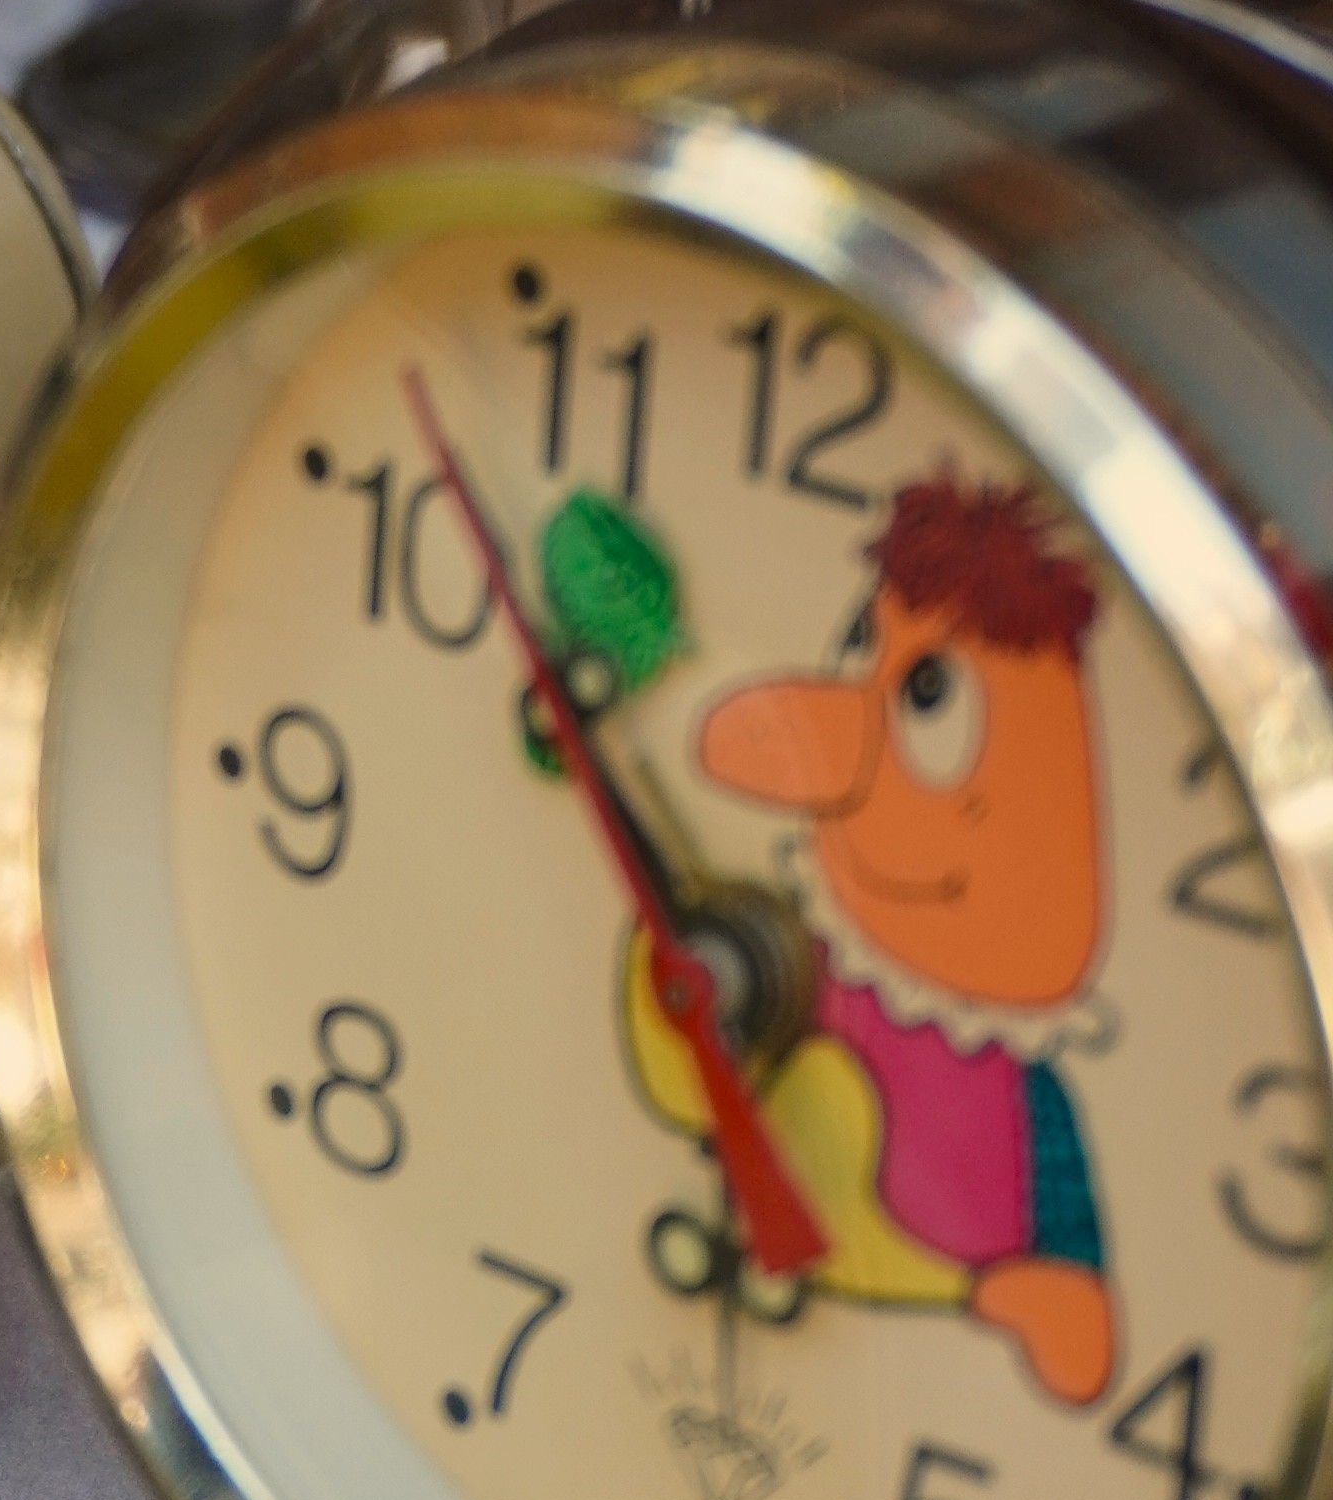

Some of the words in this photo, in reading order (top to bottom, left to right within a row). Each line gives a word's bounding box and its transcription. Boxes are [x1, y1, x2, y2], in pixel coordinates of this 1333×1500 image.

[526, 310, 653, 501] 11
[726, 308, 896, 513] 12
[257, 703, 355, 882] 9
[307, 1000, 409, 1178] 8
[472, 1244, 571, 1418] 7
